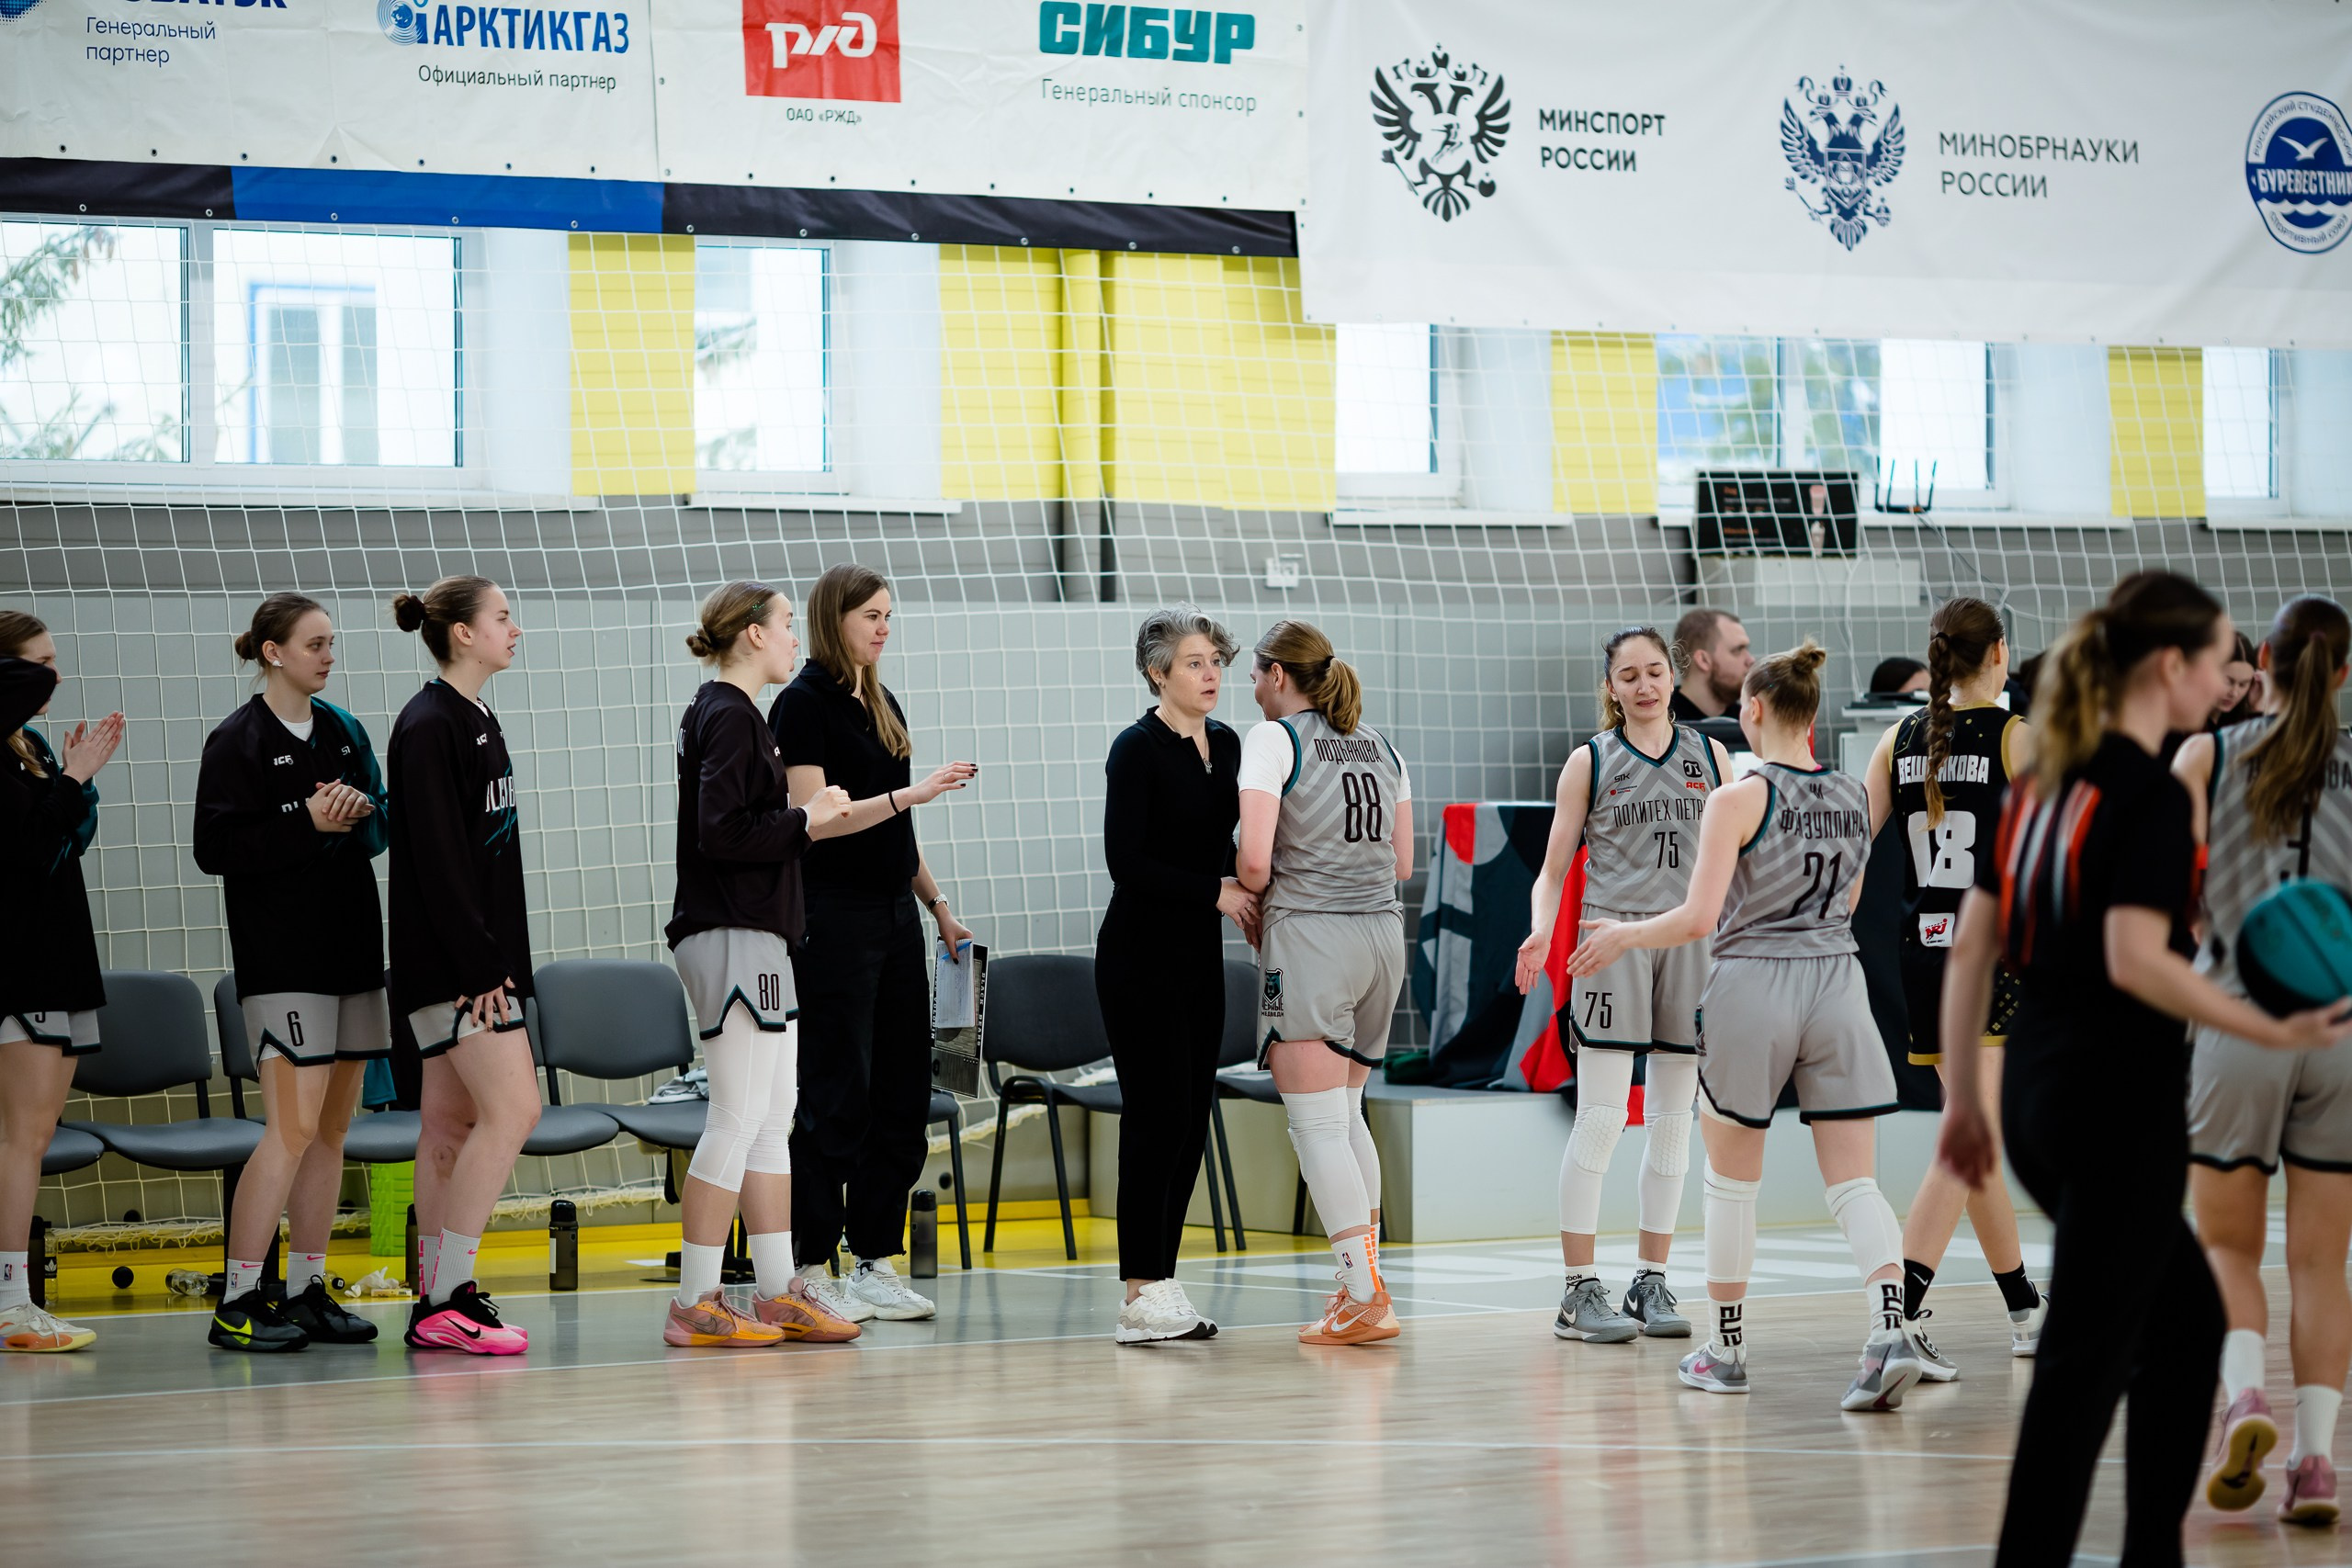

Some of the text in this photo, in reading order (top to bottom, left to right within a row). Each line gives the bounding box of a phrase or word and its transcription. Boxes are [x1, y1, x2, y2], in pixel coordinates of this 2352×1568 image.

[86, 16, 216, 41] Генеральный
[1038, 0, 1256, 64] СИБУР
[85, 45, 170, 66] партнер
[418, 64, 616, 94] Официальный партнер
[1042, 78, 1257, 113] Генеральный спонсор
[786, 107, 814, 122] ОАО
[1538, 107, 1667, 137] МИНСПОРТ
[1540, 145, 1637, 173] РОССИИ
[1939, 131, 2140, 164] МИНОБРНАУКИ
[1940, 170, 2048, 198] РОССИИ
[1341, 772, 1383, 843] 88
[1613, 797, 1707, 829] ПОЛИТЕХ ПЕТР
[1653, 830, 1679, 870] 75
[1907, 810, 1977, 889] 18
[1788, 851, 1843, 919] 21
[757, 973, 780, 1011] 80
[1583, 990, 1613, 1030] 75
[286, 1010, 305, 1047] 6
